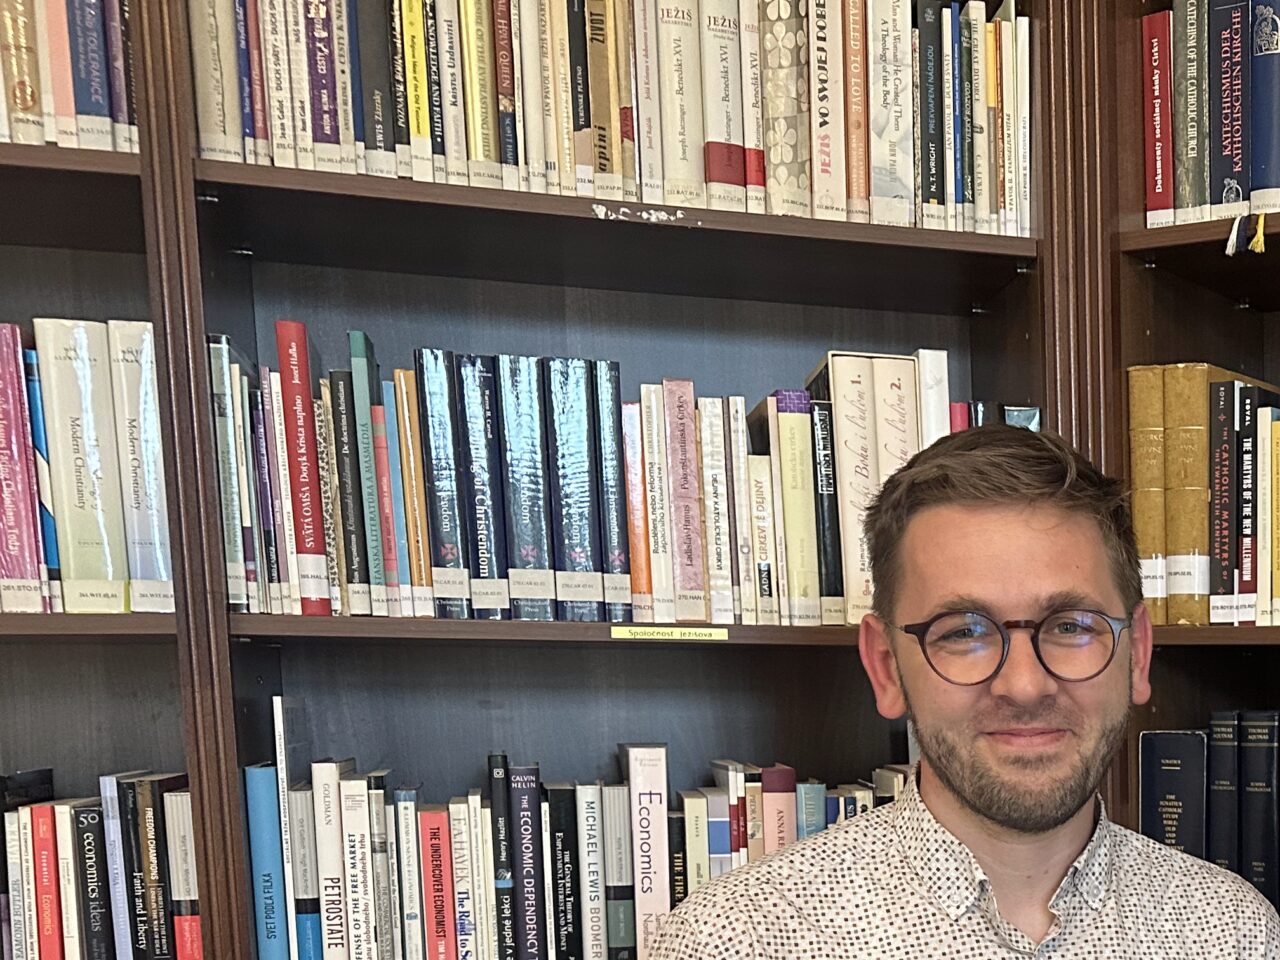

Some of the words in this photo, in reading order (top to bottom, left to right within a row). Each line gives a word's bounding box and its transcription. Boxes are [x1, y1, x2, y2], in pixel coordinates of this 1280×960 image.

[591, 12, 605, 44] ŽIVOT
[660, 8, 692, 21] JEŽIŠ
[707, 16, 738, 30] JEŽIŠ
[1222, 29, 1231, 57] DER
[1232, 8, 1241, 61] KIRCHE
[674, 58, 684, 96] Benedikt
[816, 47, 828, 102] SVOJEJ
[926, 45, 934, 82] NÁDEJOU
[1152, 69, 1160, 95] náuky
[678, 104, 686, 136] Ratzinger
[818, 107, 829, 128] VO
[926, 83, 936, 134] PREKVAPENÍ
[1152, 99, 1161, 138] sociálnej
[1222, 61, 1231, 155] KATECHISMUS
[1233, 66, 1242, 172] KATHOLISCHEN
[679, 137, 687, 160] Joseph
[819, 134, 831, 177] JEŽIŠ
[293, 395, 306, 425] naplno
[296, 428, 306, 453] Krista
[298, 455, 309, 482] Dotyk
[300, 486, 311, 515] OMŠA
[322, 783, 333, 825] GOLDMAN
[429, 827, 440, 840] THE
[497, 817, 506, 840] Hazlitt
[520, 811, 533, 875] ECONOMIC
[586, 801, 598, 856] MICHAEL
[639, 791, 662, 893] Economics
[84, 833, 101, 898] economics
[498, 842, 507, 861] Henry
[431, 844, 443, 901] UNDERCOVER
[588, 862, 599, 902] LEWIS
[91, 901, 102, 931] ideas
[325, 878, 343, 948] PETROSTATE
[434, 903, 446, 938] ECONOMIST
[523, 878, 537, 954] DEPENDENCY
